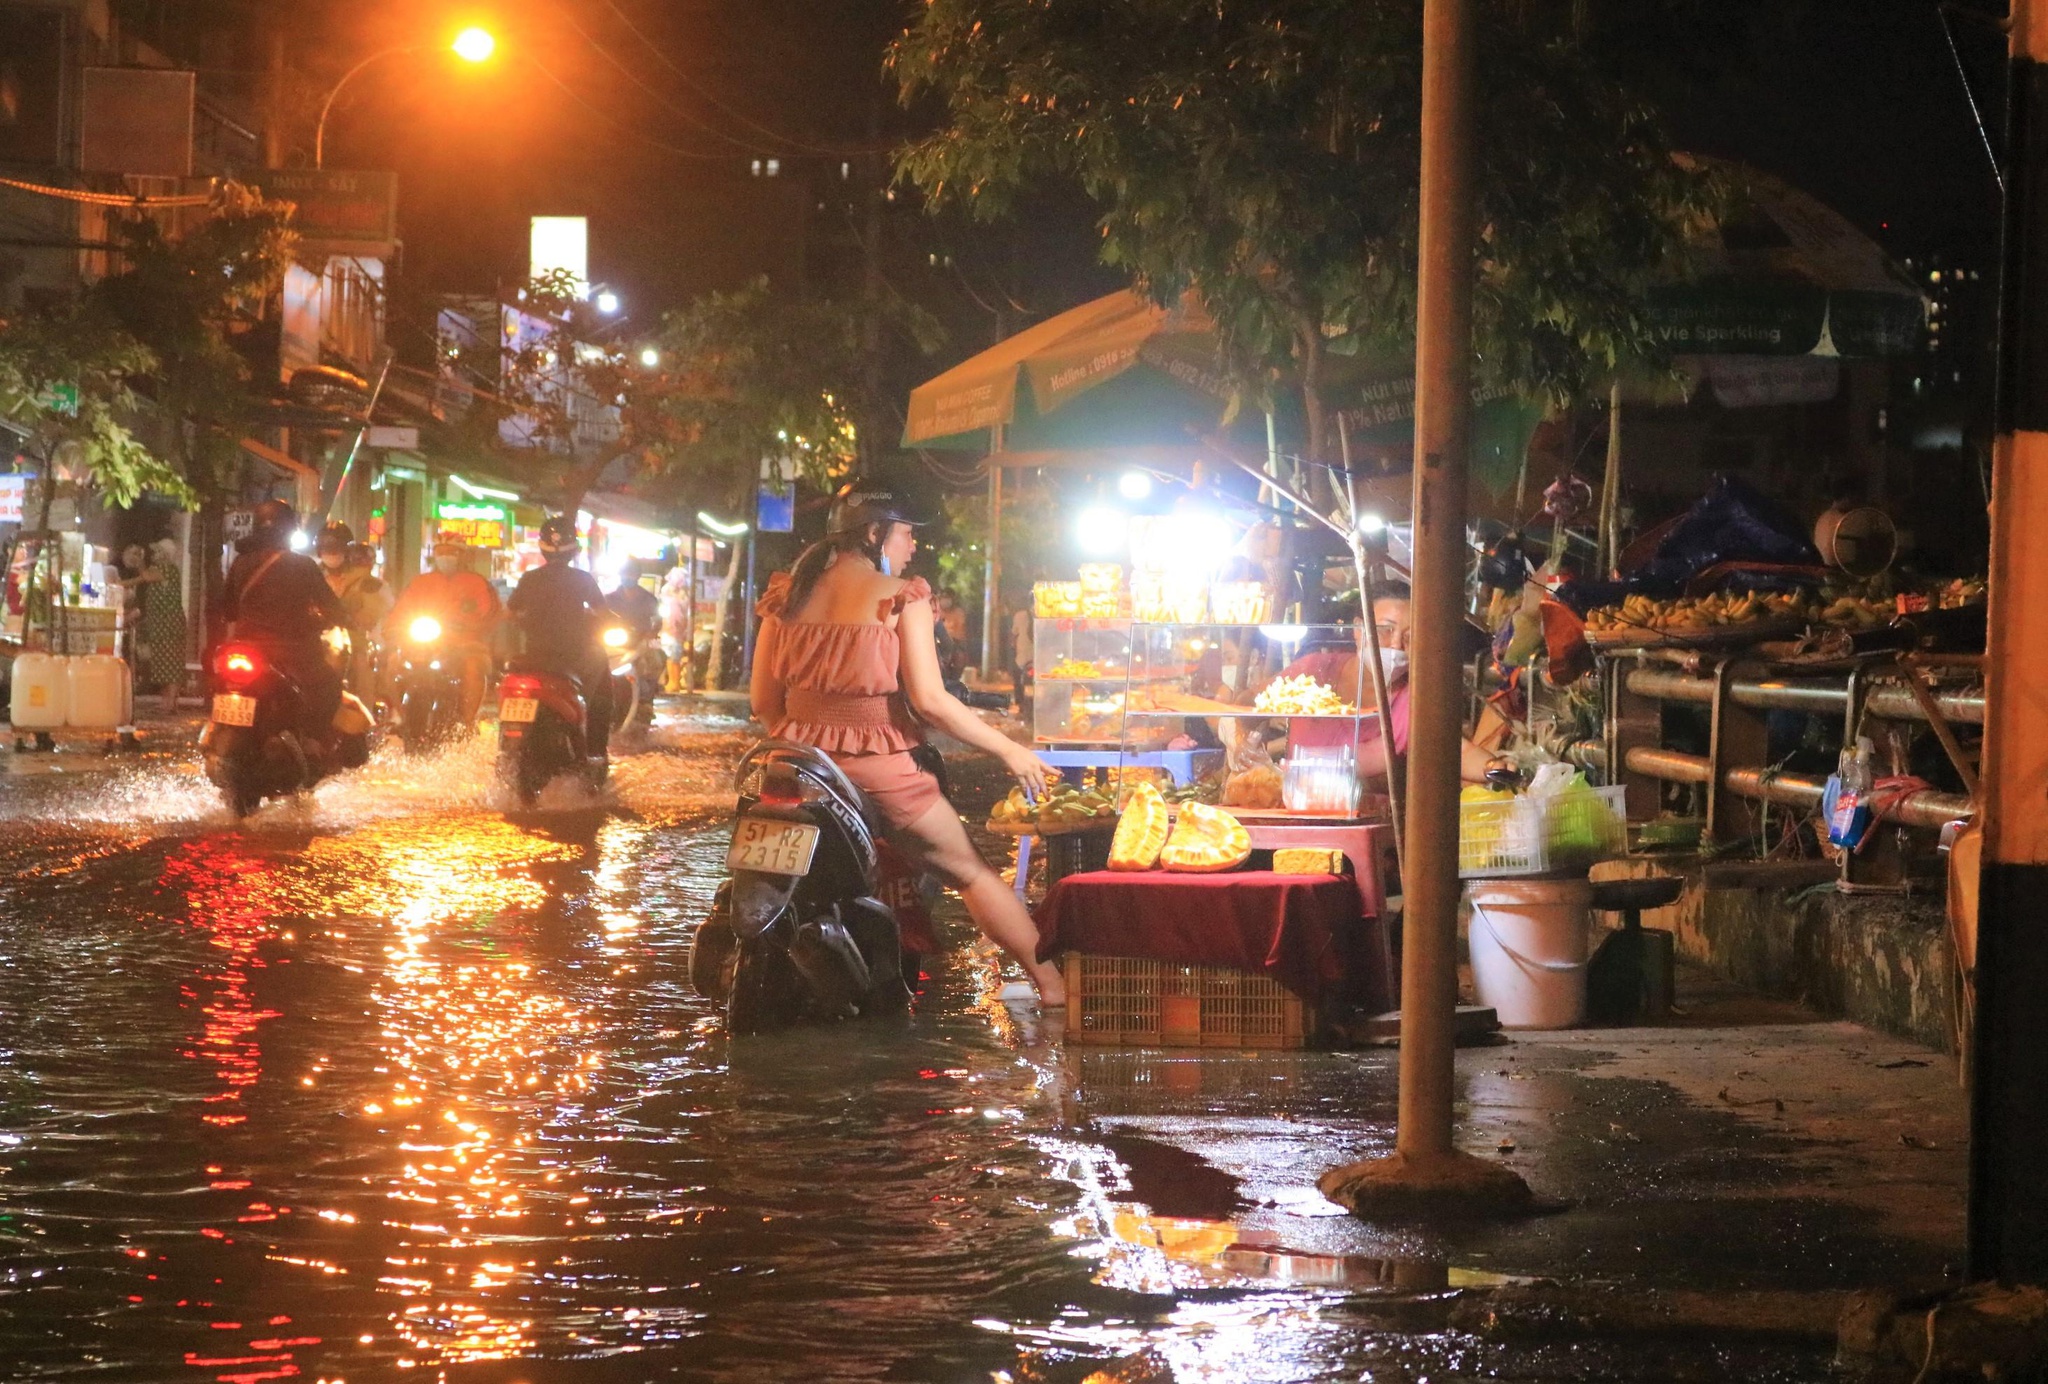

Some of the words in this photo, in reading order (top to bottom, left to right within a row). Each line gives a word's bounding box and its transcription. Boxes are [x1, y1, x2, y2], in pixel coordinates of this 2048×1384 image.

[1659, 325, 1688, 341] Vie
[1694, 324, 1780, 343] Sparkling
[1050, 365, 1087, 393] Hotline
[1093, 346, 1118, 373] 0916
[862, 491, 893, 502] PIAGGIO
[738, 844, 801, 871] 2315
